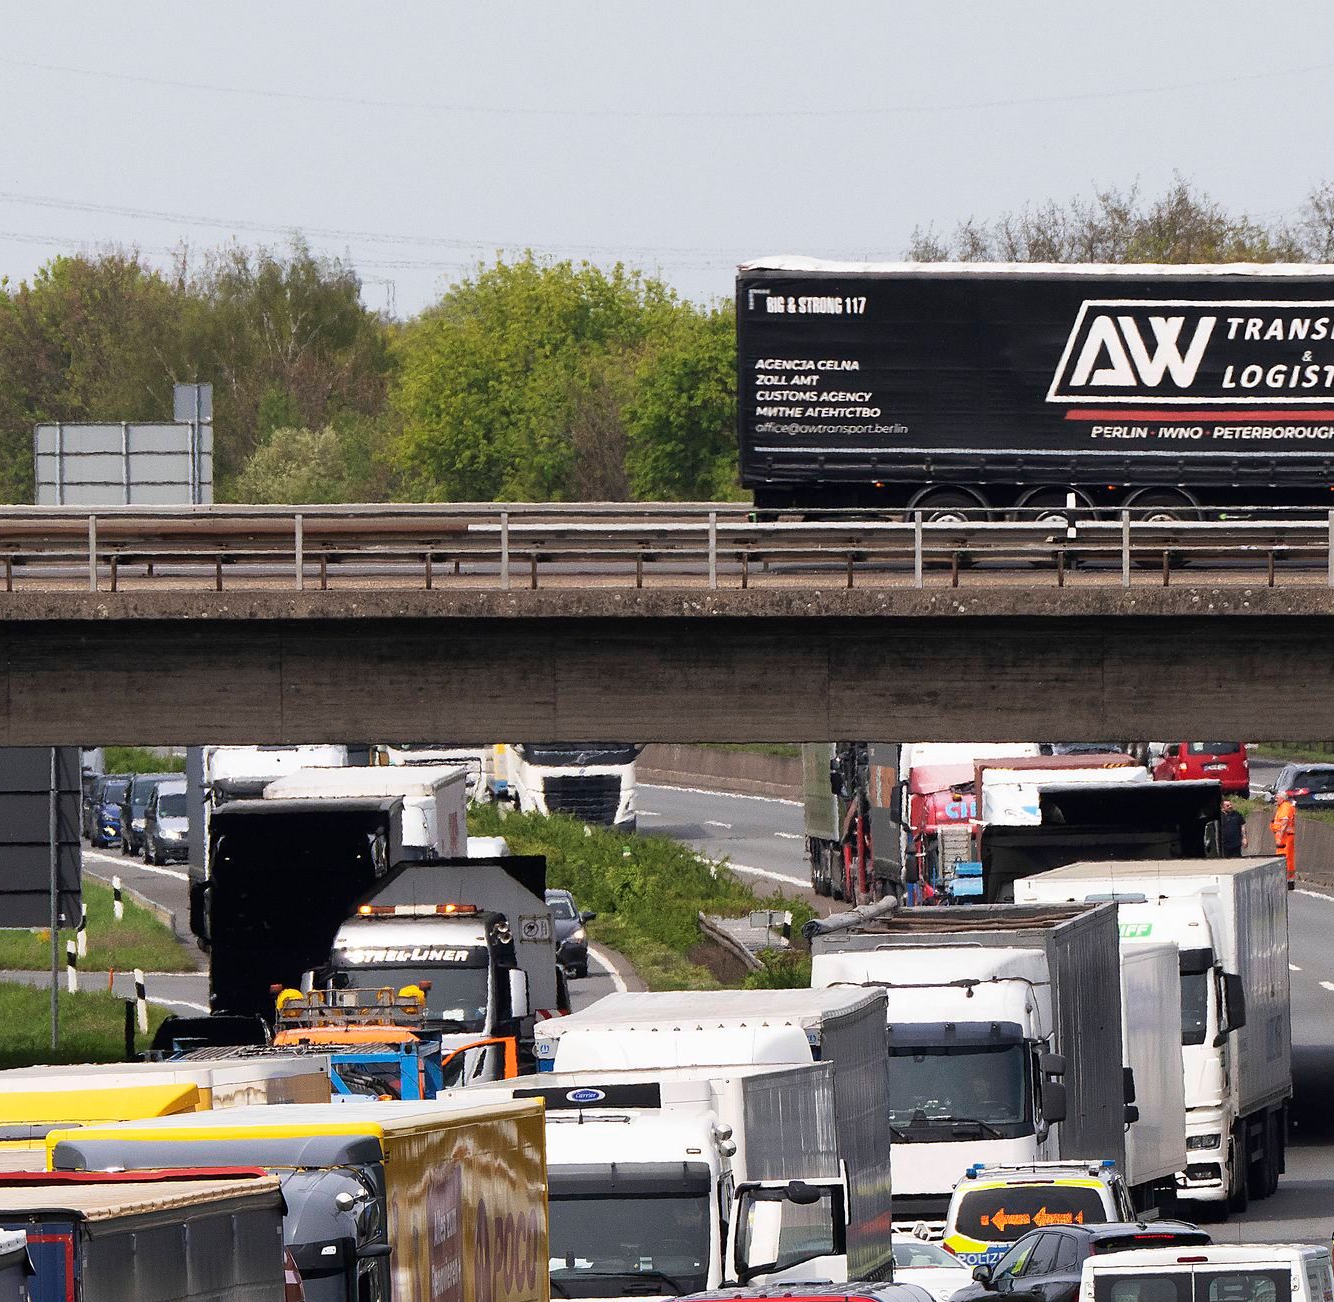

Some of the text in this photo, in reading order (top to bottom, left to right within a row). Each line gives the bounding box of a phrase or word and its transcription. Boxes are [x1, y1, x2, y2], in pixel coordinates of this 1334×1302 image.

[766, 296, 867, 315] BIG & STRONG 117
[1069, 315, 1217, 387] AW
[1302, 350, 1313, 362] &
[755, 359, 860, 371] AGENCJA CELNA
[755, 375, 820, 386] ZOLL AMT
[755, 390, 873, 402] CUSTOMS AGENCY
[755, 421, 909, 436] office@awtransport.berlin
[1158, 427, 1203, 440] IWNO
[494, 1208, 538, 1296] POCO
